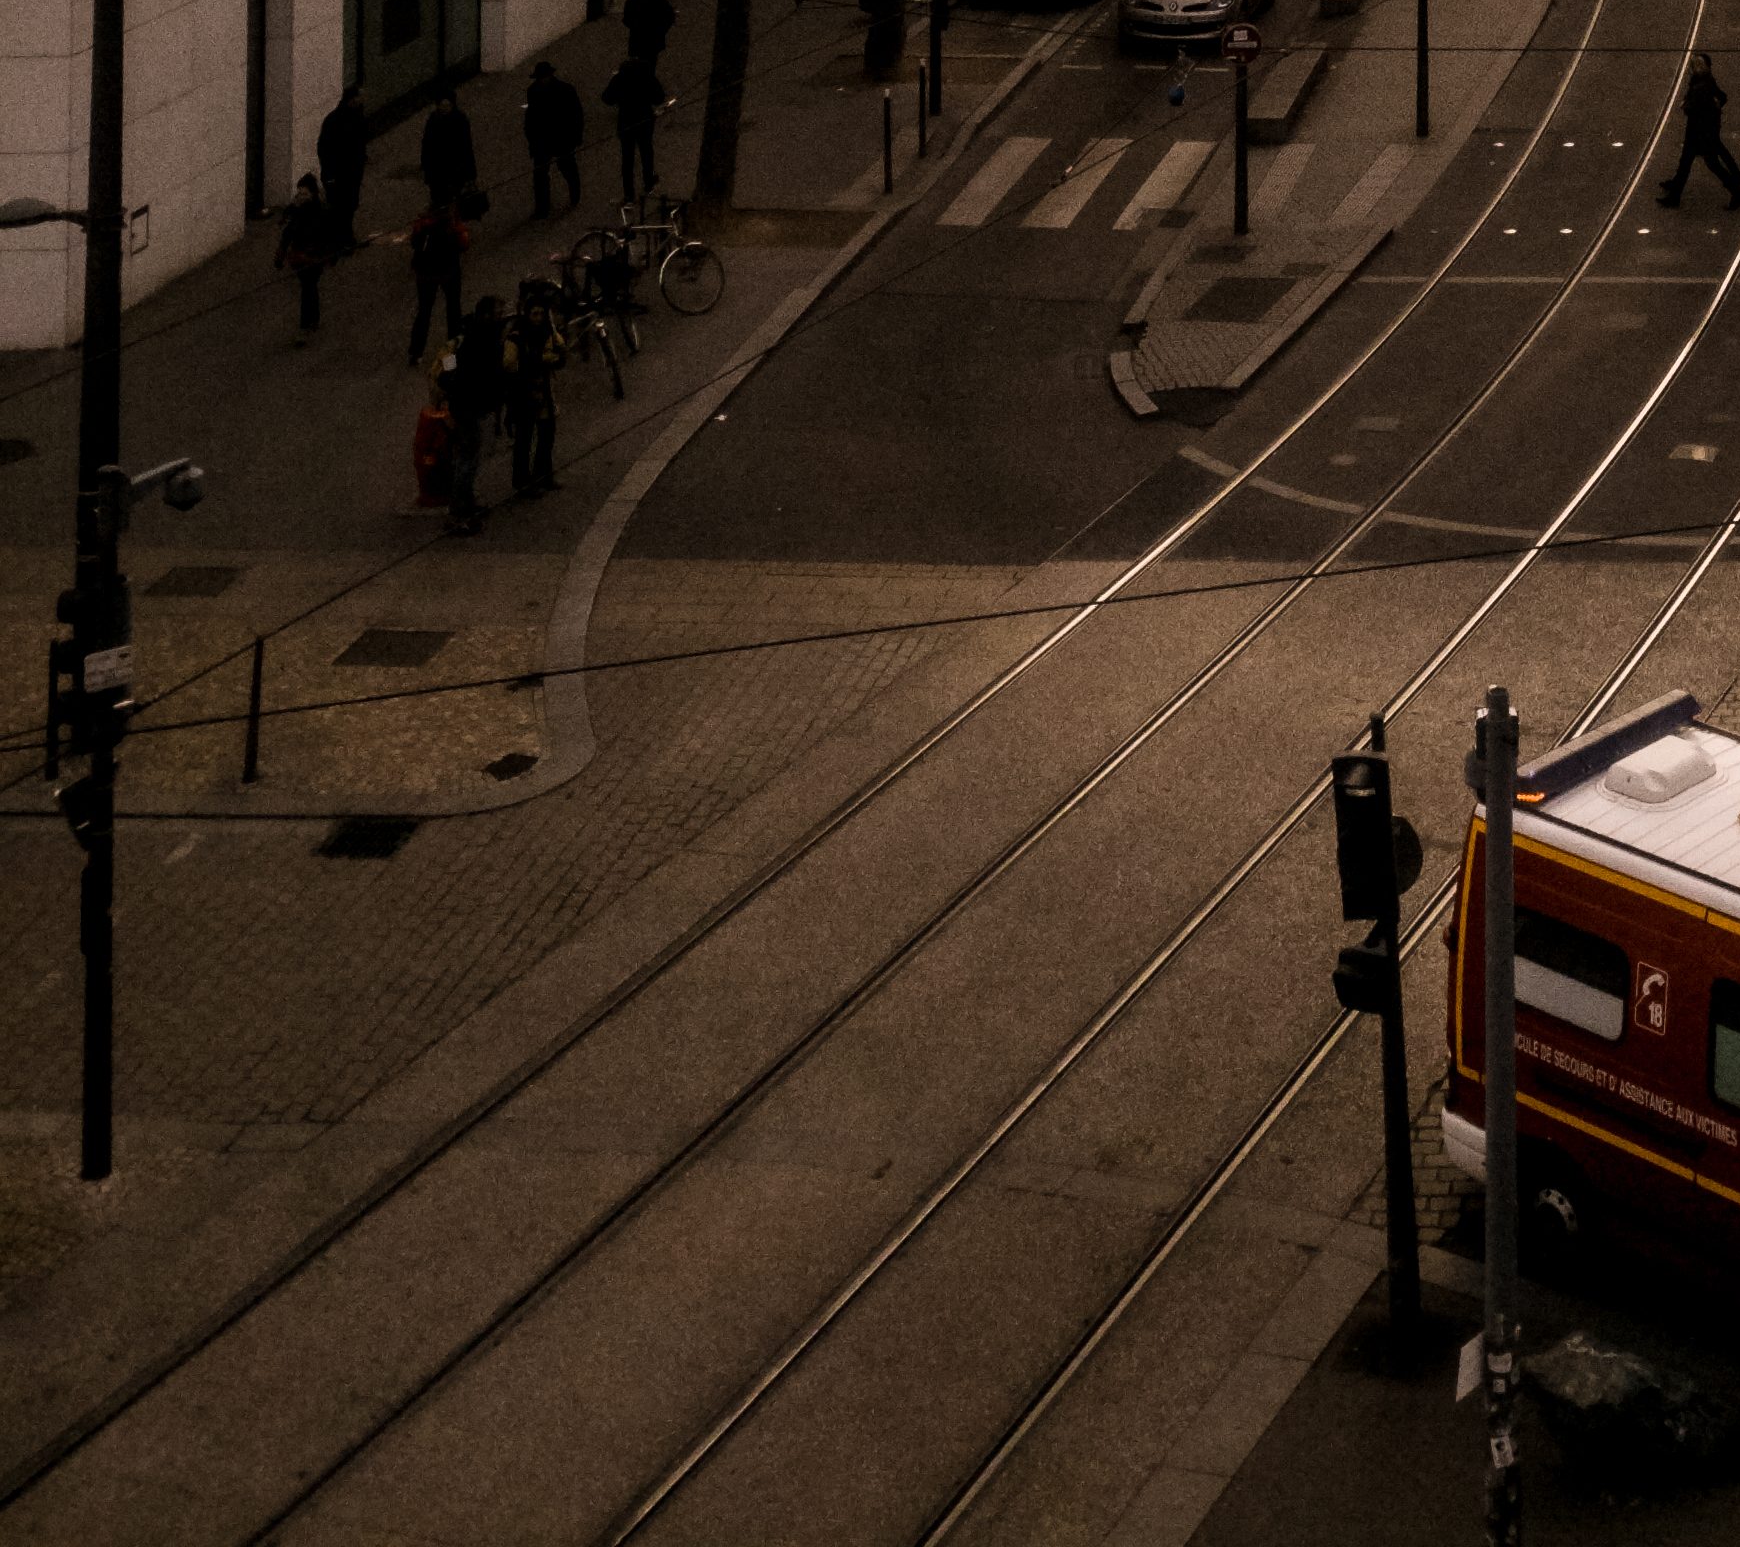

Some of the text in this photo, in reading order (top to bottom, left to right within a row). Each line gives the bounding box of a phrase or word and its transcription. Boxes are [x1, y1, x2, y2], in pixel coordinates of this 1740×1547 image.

[1648, 1001, 1663, 1028] 18
[1554, 1051, 1595, 1083] SECOURS
[1596, 1068, 1609, 1089] ET
[1619, 1079, 1674, 1119] ASSISTANCE
[1675, 1103, 1695, 1127] AUX
[1695, 1113, 1738, 1147] VICTIMES
